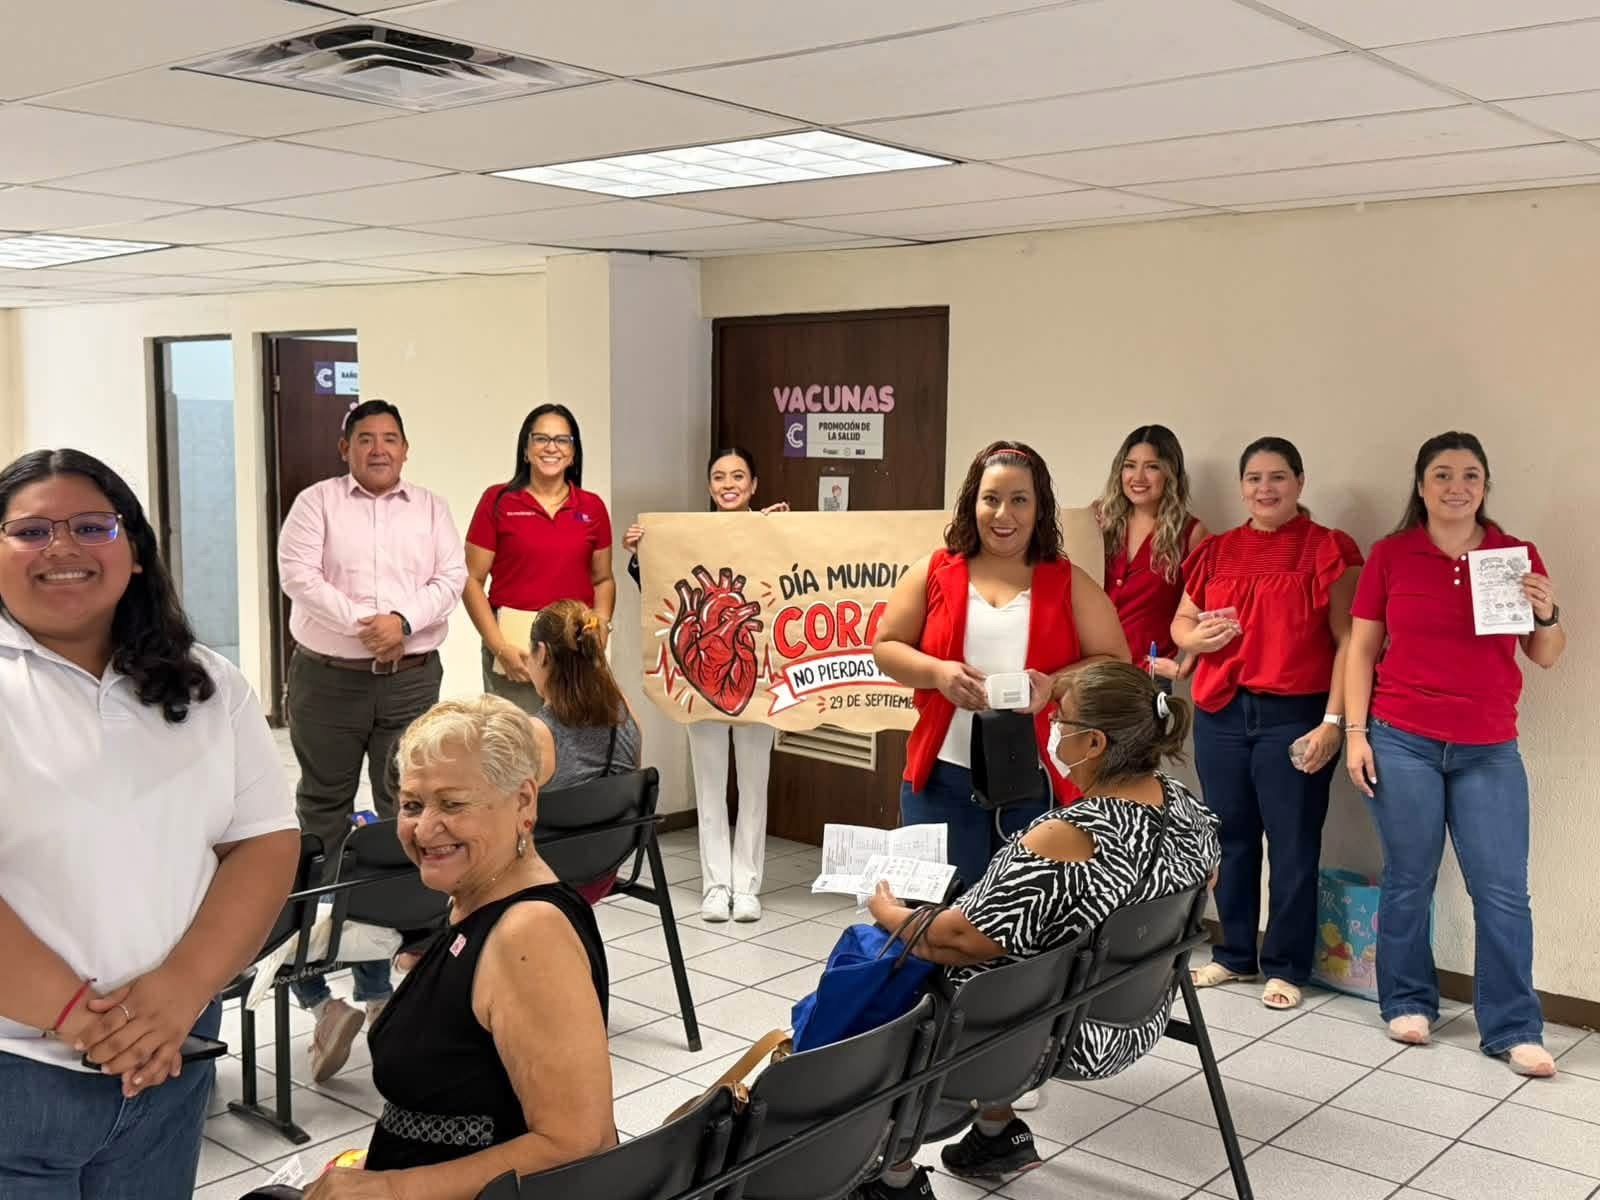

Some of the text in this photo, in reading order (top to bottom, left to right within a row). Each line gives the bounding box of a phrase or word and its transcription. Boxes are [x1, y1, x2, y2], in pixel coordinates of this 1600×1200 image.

[773, 384, 896, 413] VACUNAS
[818, 420, 871, 431] PROMOCIÓN DE
[828, 432, 861, 440] LA SALUD
[779, 563, 820, 600] DÍA
[793, 660, 874, 688] NO PIERDAS
[830, 696, 843, 709] 29
[847, 694, 860, 708] DE
